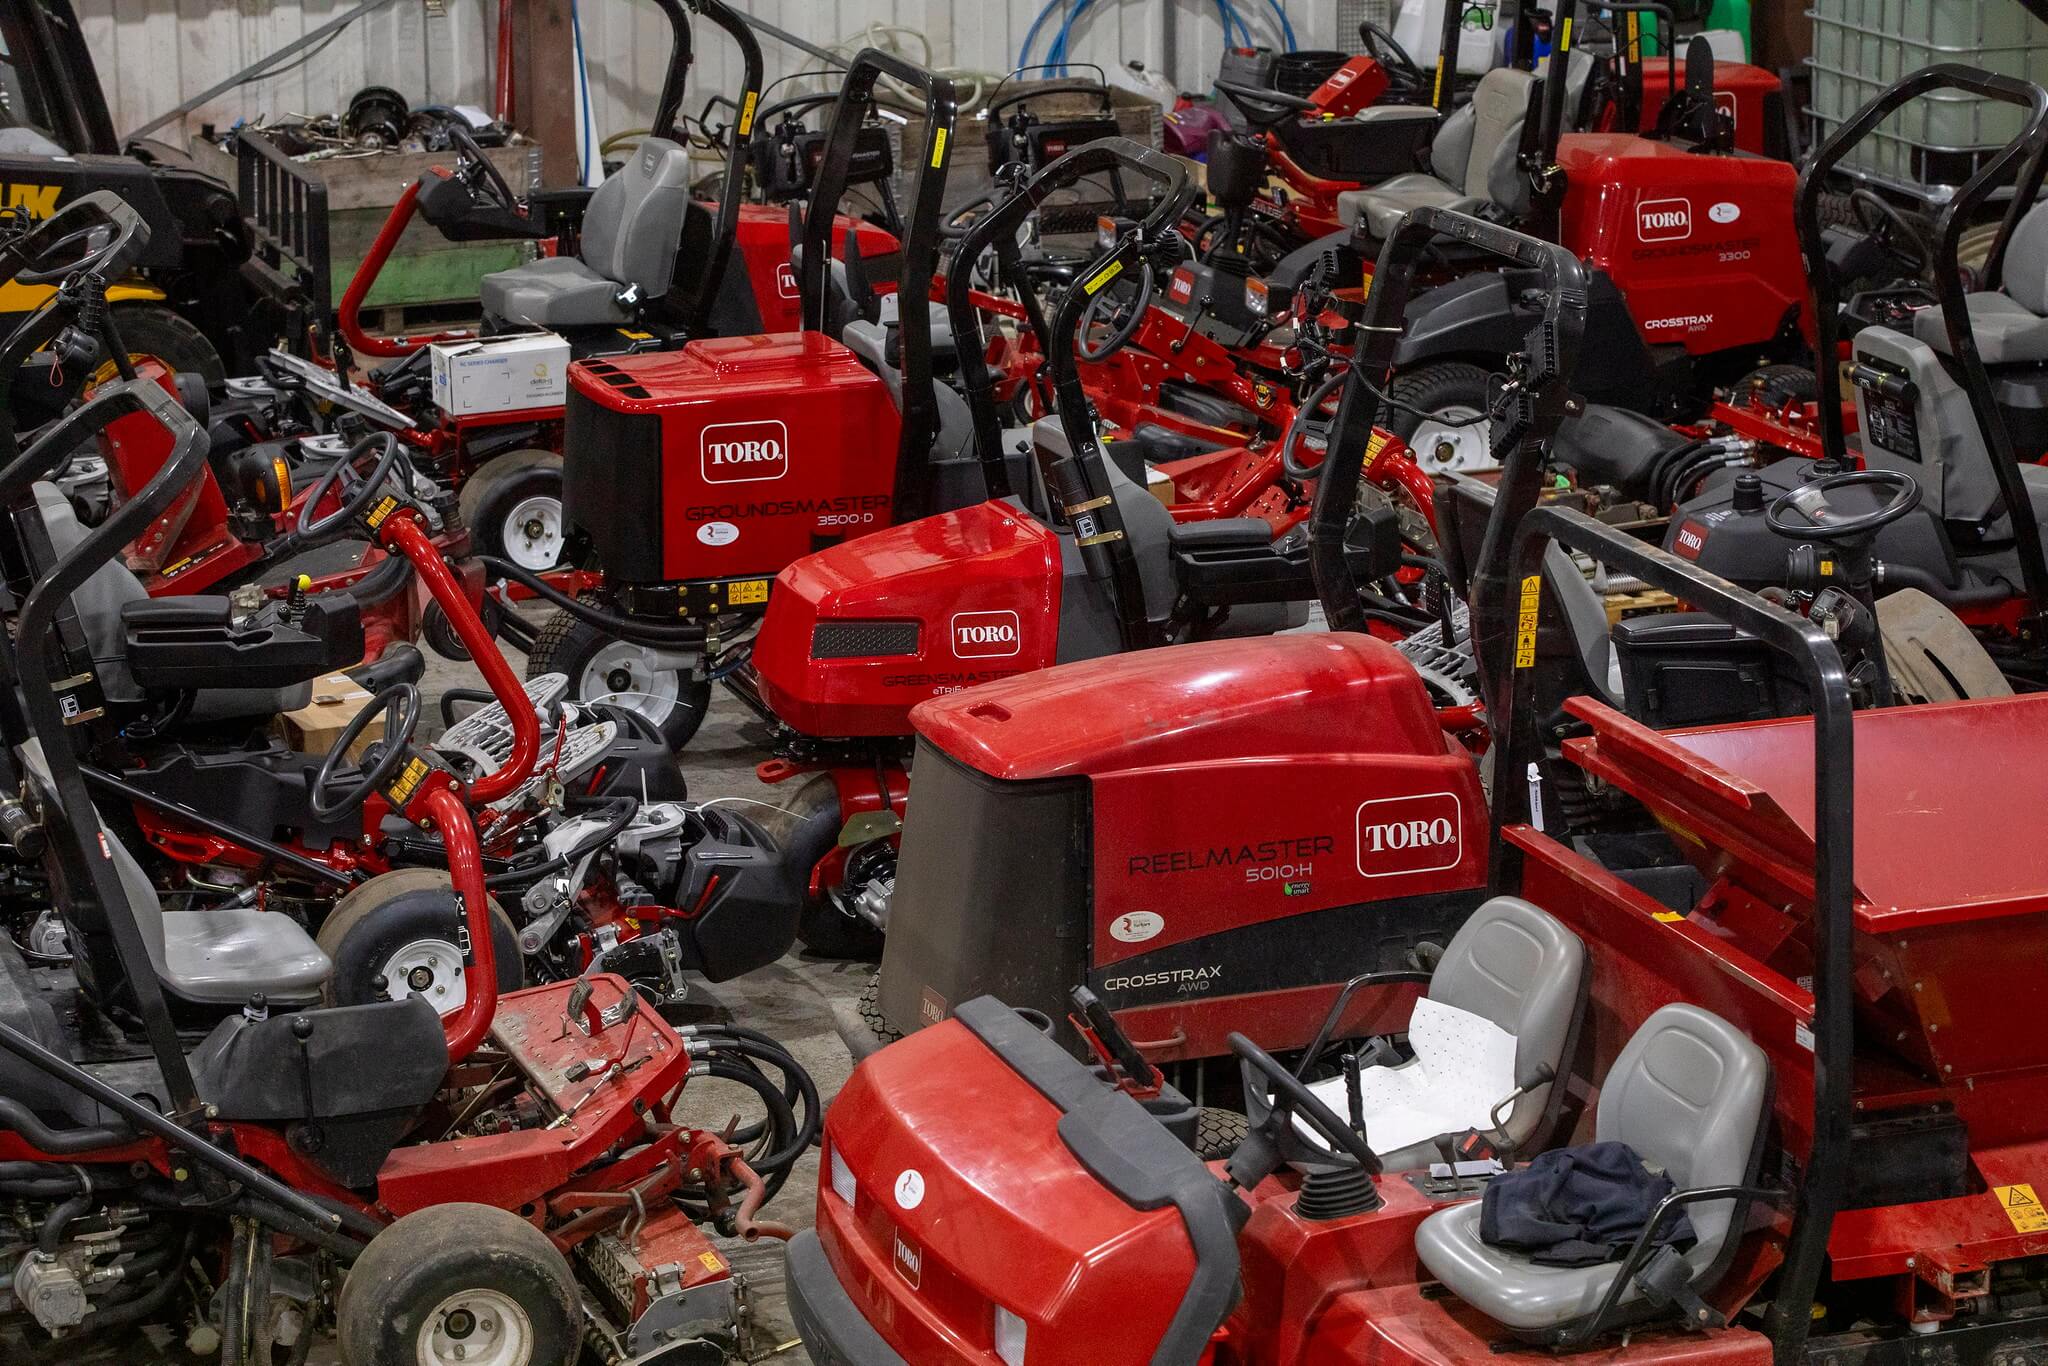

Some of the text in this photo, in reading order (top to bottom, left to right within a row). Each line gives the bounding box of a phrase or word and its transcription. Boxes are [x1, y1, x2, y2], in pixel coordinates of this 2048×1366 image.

[1642, 211, 1687, 229] TORO
[1719, 250, 1750, 262] 3300
[1173, 278, 1191, 296] TORO
[1645, 314, 1713, 329] CROSSTRAX
[1688, 324, 1707, 333] AWD
[708, 439, 780, 465] TORO
[685, 494, 890, 521] GROUNDSMASTER
[1679, 529, 1702, 550] TORO
[958, 624, 1014, 643] TORO
[1365, 818, 1453, 852] TORO
[1128, 836, 1334, 875] REELMASTER
[1104, 965, 1222, 991] CROSSTRAX
[1177, 980, 1210, 993] AWD
[897, 1238, 919, 1272] TORO
